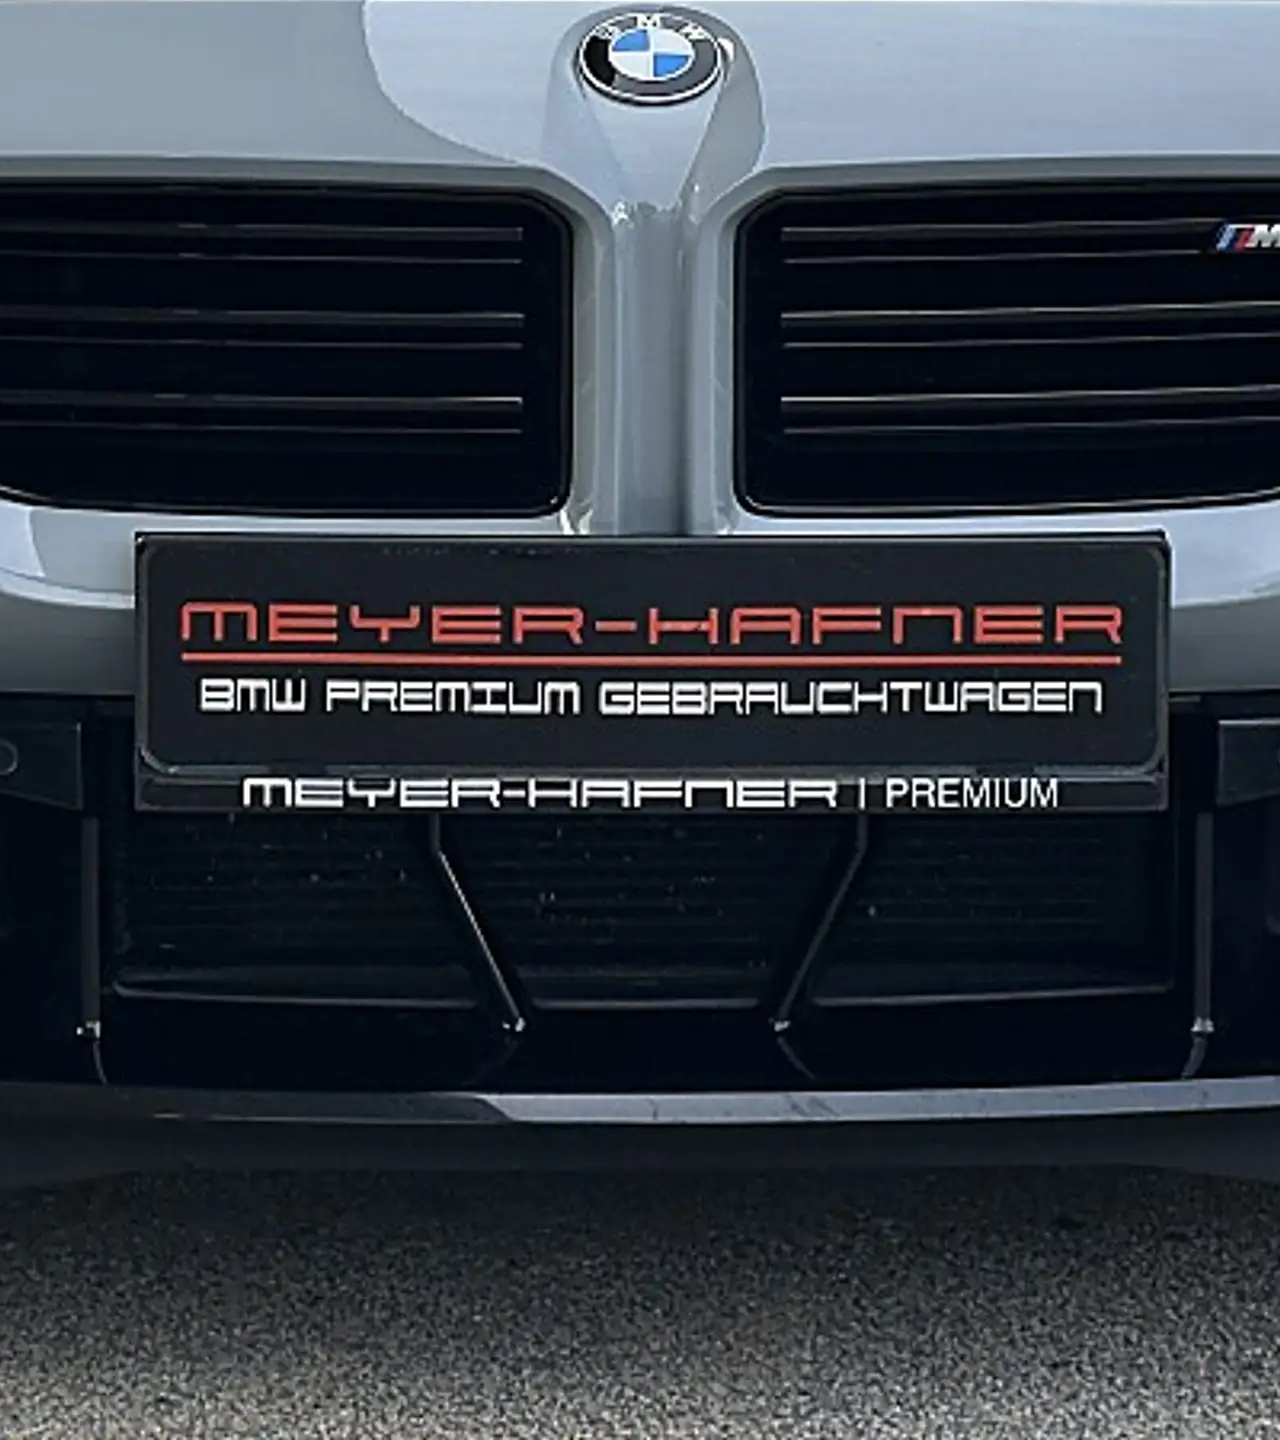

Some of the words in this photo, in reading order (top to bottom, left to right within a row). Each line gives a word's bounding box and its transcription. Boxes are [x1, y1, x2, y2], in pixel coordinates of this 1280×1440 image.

[180, 601, 1124, 646] MEYER-HAFNER
[199, 677, 307, 713] BMW
[325, 680, 581, 716] PREMIUM
[598, 680, 1104, 716] GEBRAUCHTWAGEN
[242, 776, 838, 809] MEYER-HAFNER
[886, 776, 1059, 809] PREMIUM
